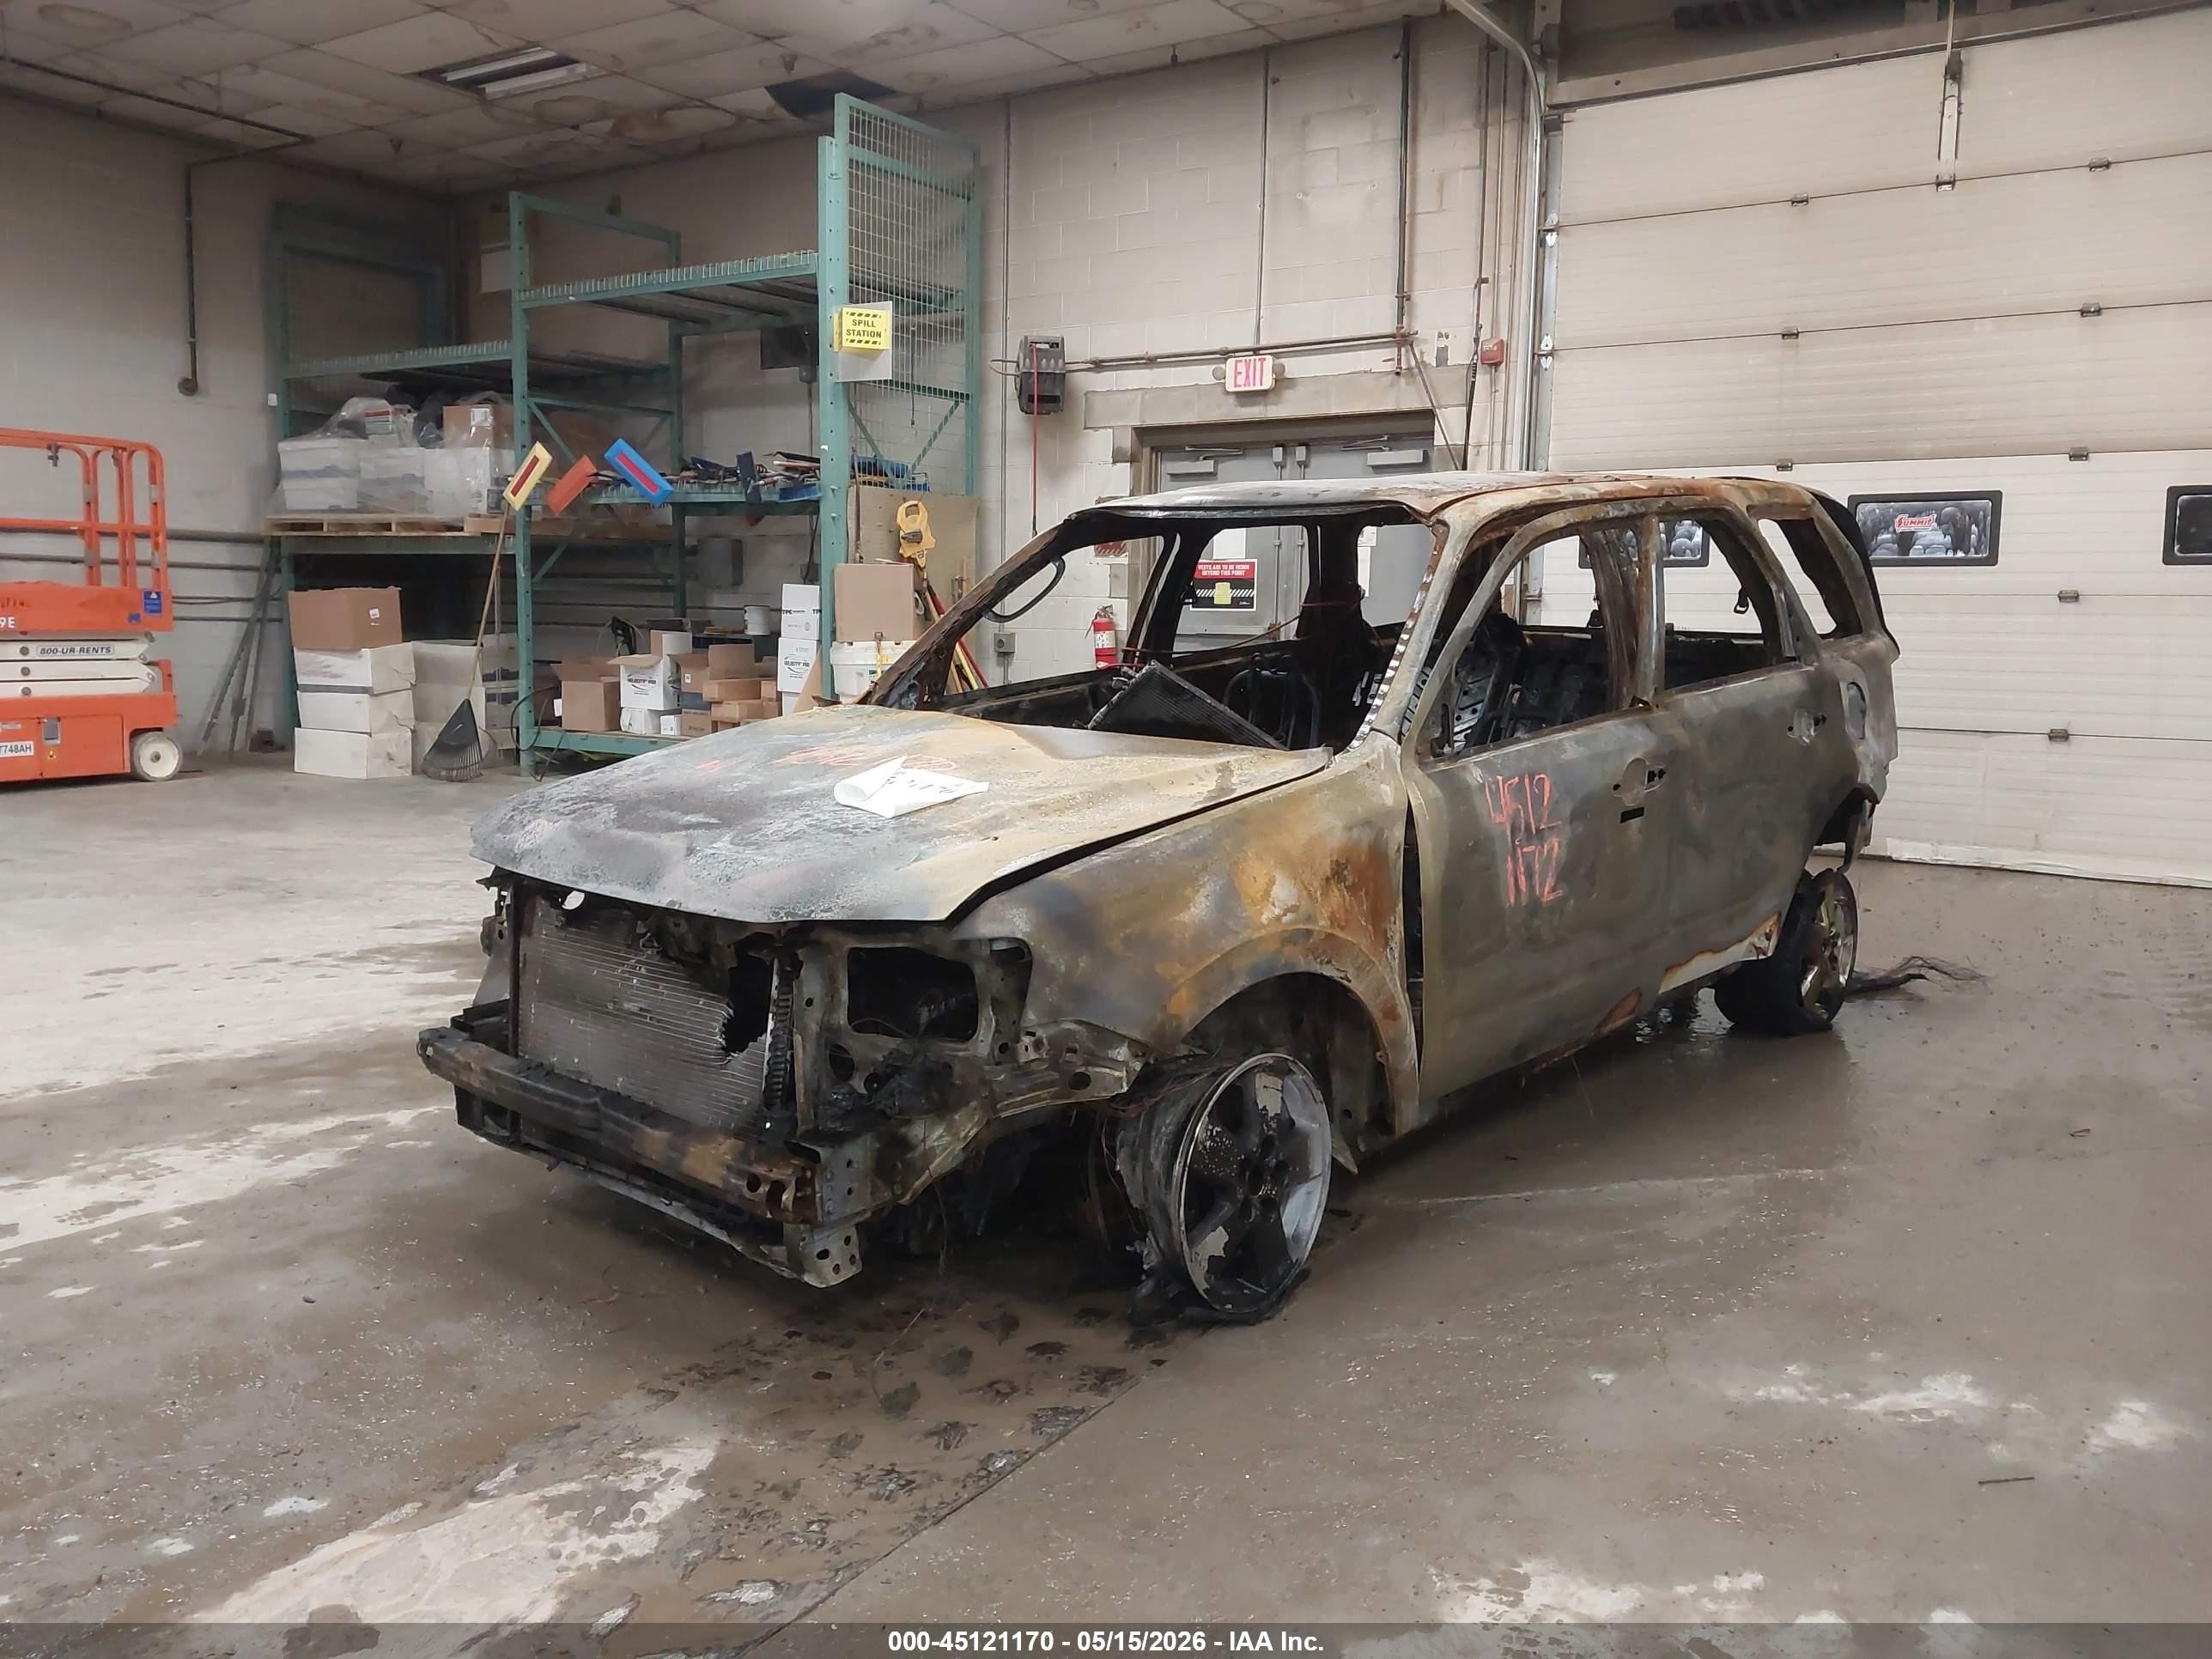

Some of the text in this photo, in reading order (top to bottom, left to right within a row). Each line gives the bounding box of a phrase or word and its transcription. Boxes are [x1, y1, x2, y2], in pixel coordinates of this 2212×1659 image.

[852, 319, 877, 328] SPILL
[846, 328, 882, 338] STATION
[1233, 357, 1266, 388] EXIT
[1896, 515, 1935, 529] SUMMIT
[1485, 772, 1562, 845] 4512
